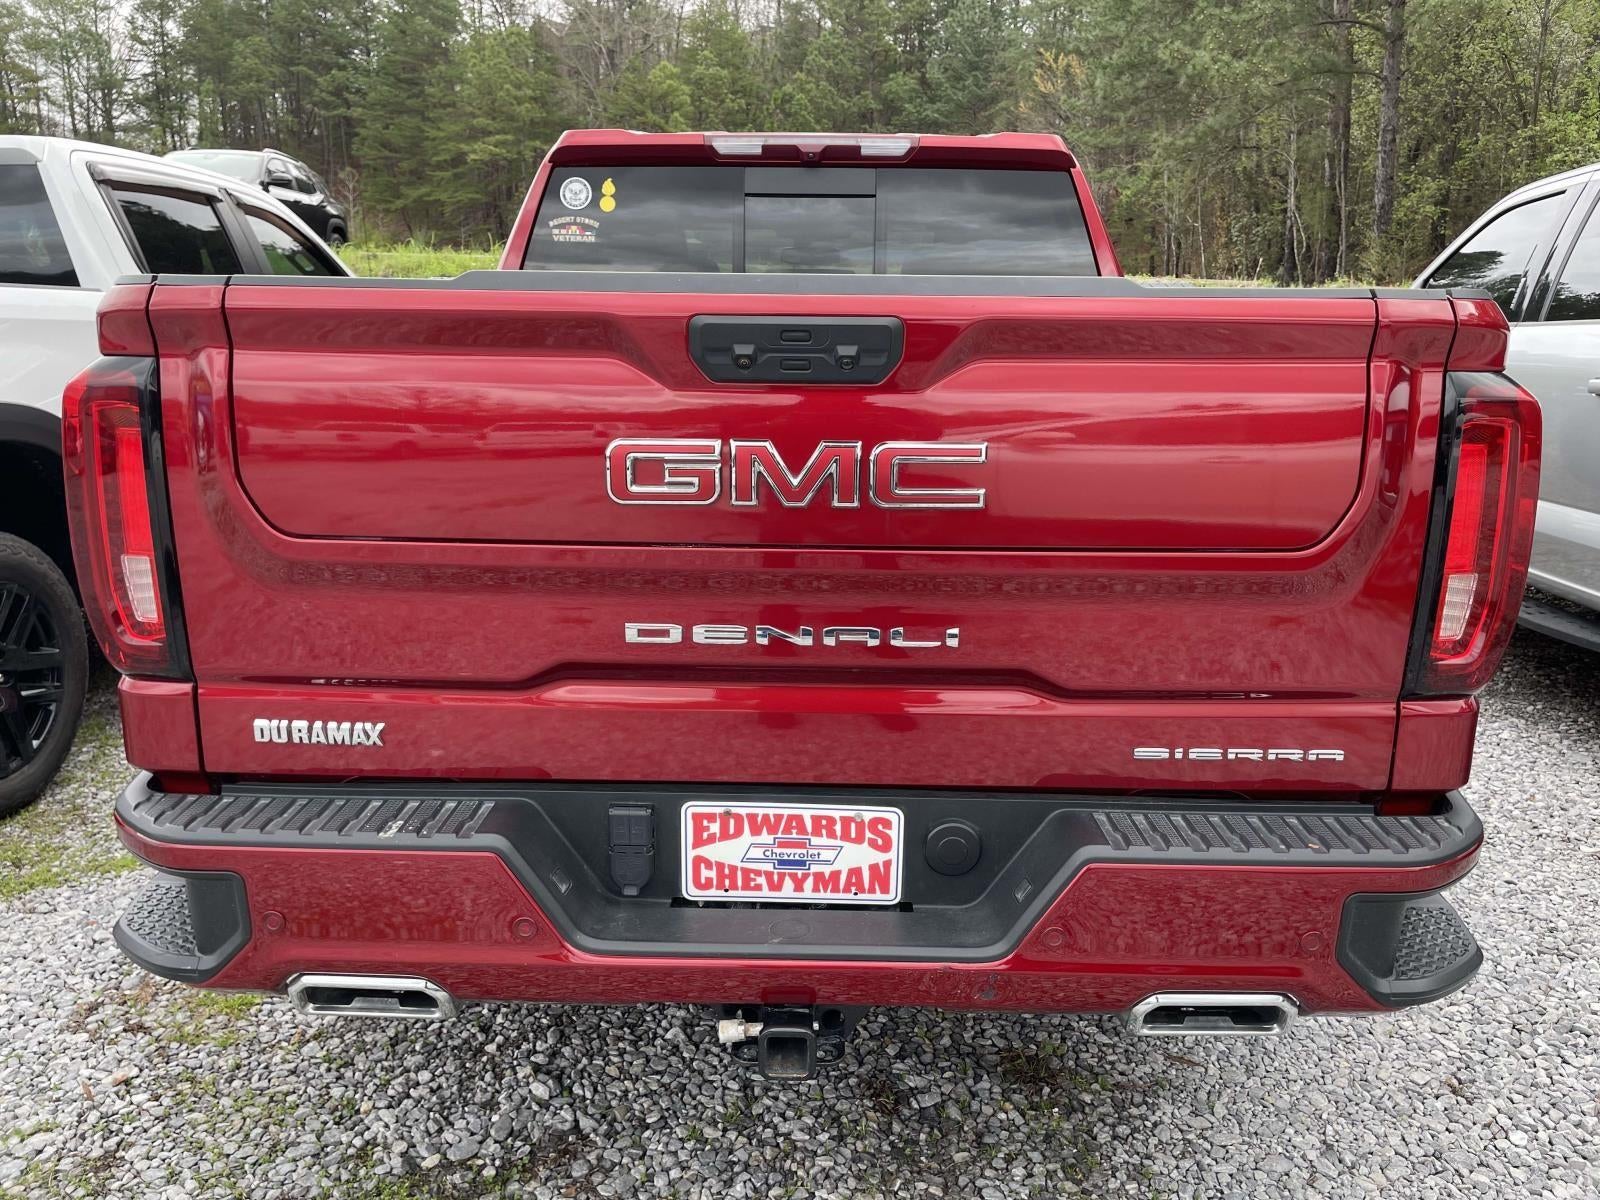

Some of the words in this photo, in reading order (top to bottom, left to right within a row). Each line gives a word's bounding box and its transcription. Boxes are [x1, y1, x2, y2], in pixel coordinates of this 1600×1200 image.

[549, 216, 575, 227] DESERT
[575, 216, 600, 228] STORM
[605, 437, 988, 509] GMC
[625, 622, 960, 649] DENALI
[253, 718, 385, 747] DURAMAX
[1133, 747, 1345, 762] SIERRA
[692, 811, 893, 854] EDWARDS
[762, 848, 822, 860] Chevrolet
[692, 854, 892, 895] CHEVYMAN
